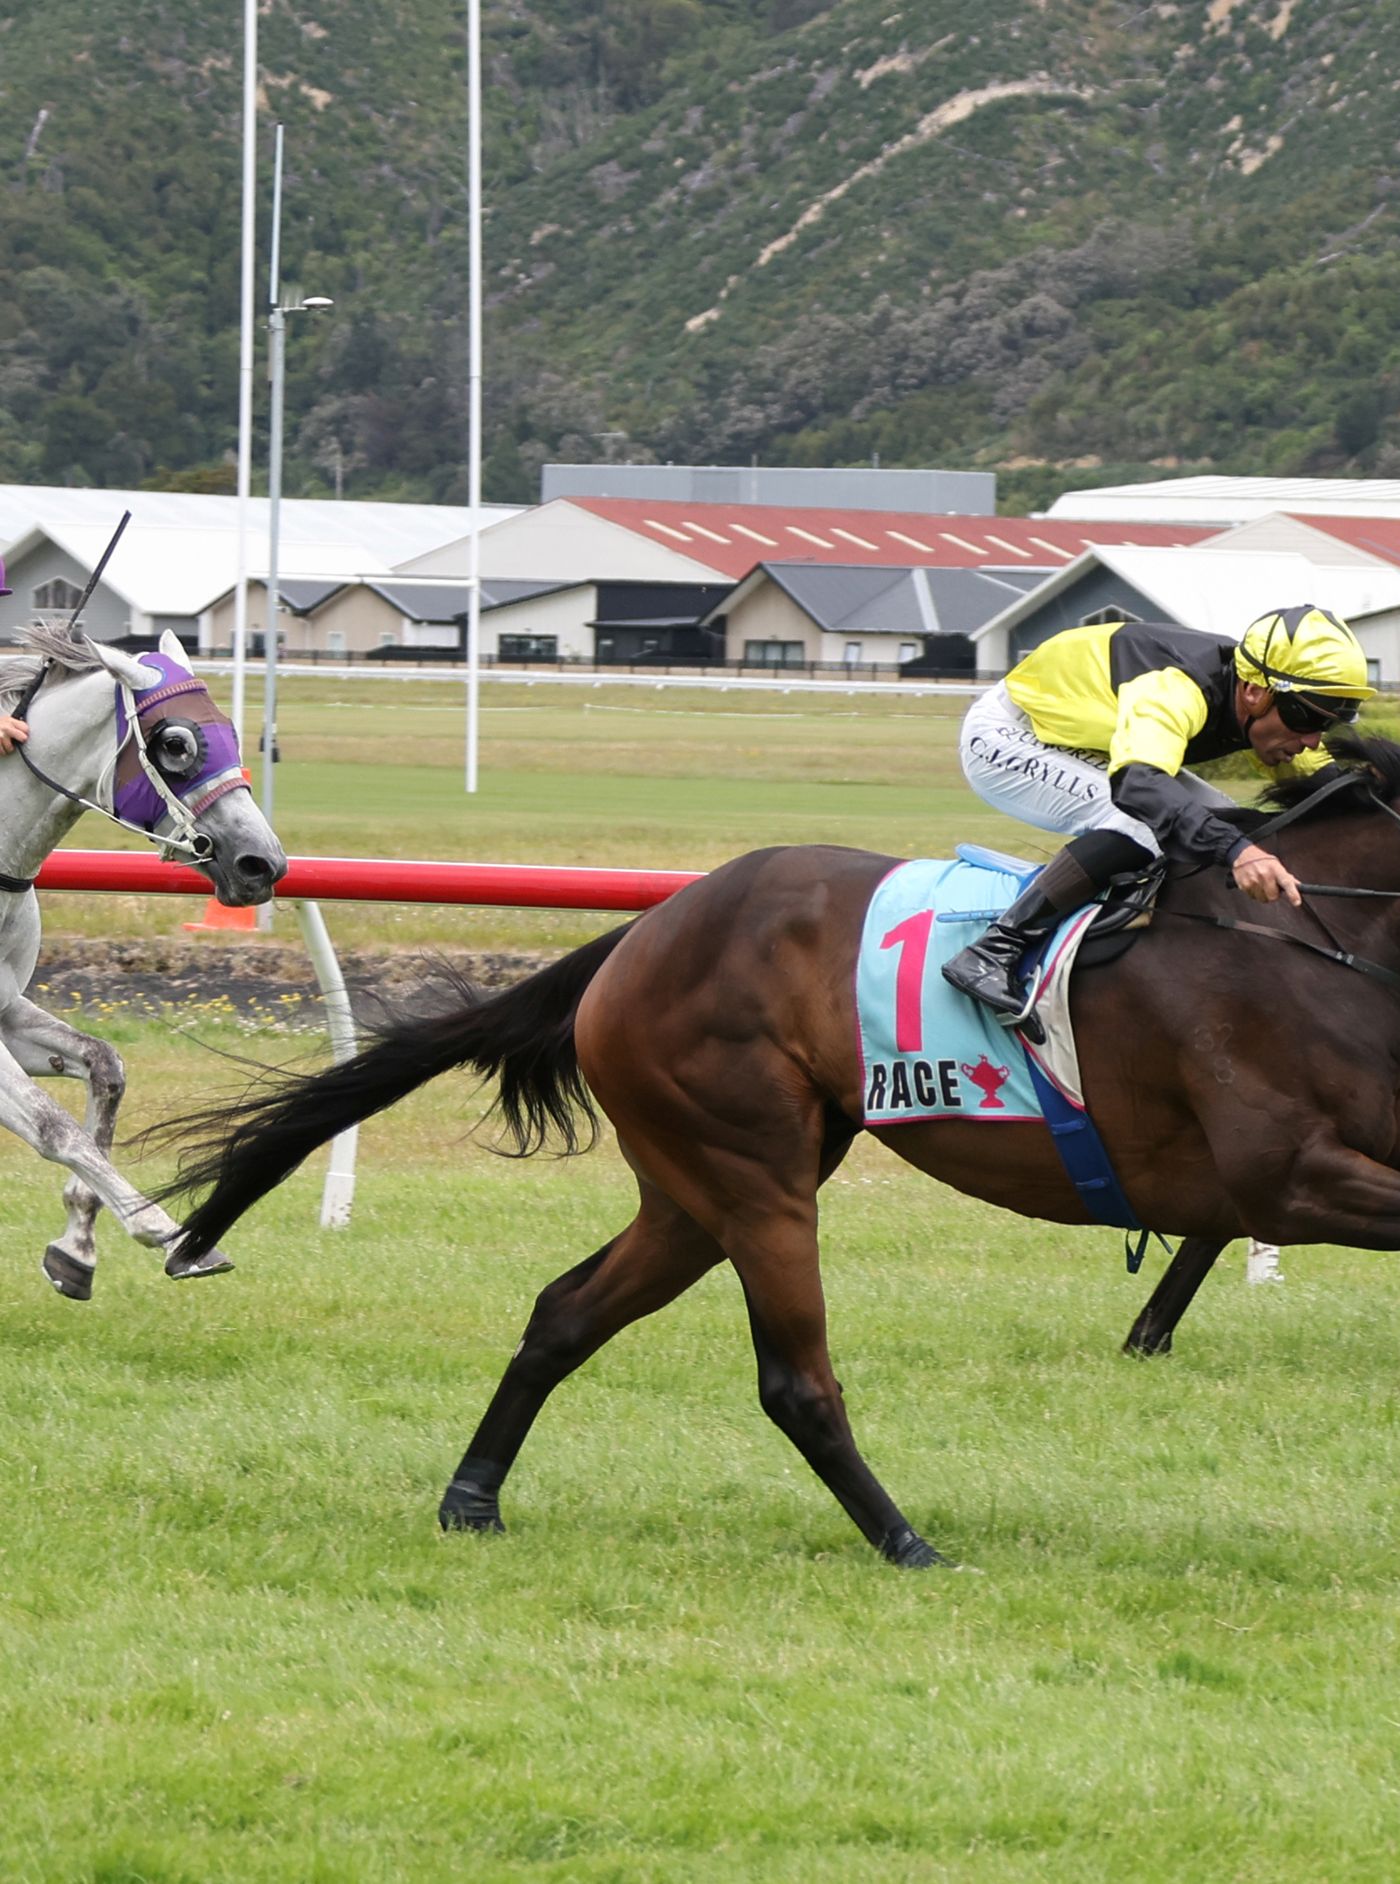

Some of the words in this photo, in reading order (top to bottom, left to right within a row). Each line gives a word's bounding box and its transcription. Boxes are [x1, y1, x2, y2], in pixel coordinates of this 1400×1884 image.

[970, 736, 1099, 801] C.J.GRYLLS
[879, 908, 935, 1053] 1
[866, 1060, 962, 1111] RACE
